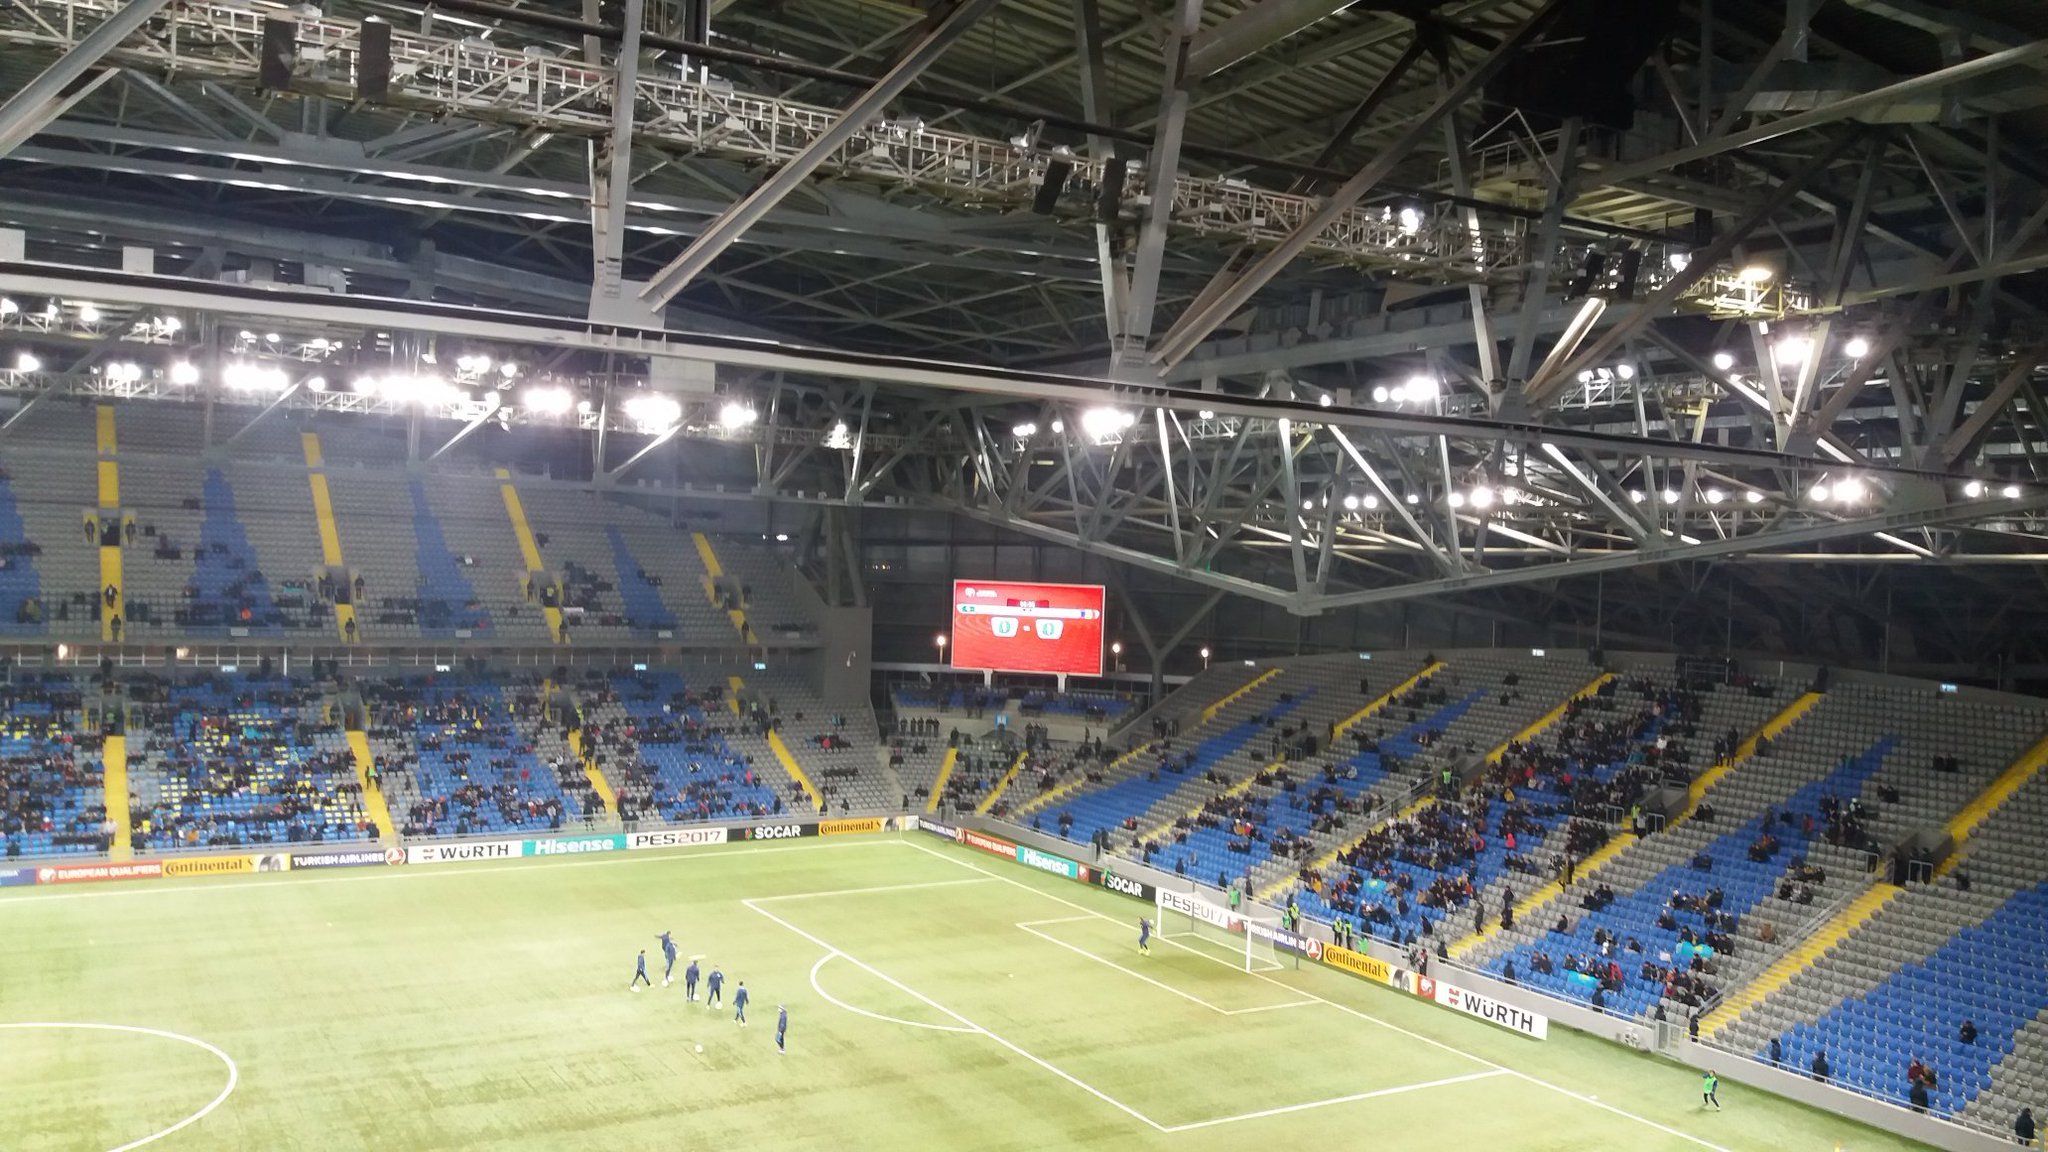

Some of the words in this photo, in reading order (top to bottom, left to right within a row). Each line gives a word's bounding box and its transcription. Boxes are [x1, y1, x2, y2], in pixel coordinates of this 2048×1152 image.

[754, 824, 801, 840] SOCAR
[820, 821, 875, 835] Continental
[440, 843, 509, 860] WÜRTH
[535, 838, 614, 856] Hisense
[164, 858, 243, 876] Continental
[293, 853, 338, 866] TURKISH
[338, 852, 385, 864] AIRLINES
[1023, 846, 1070, 877] Hisense
[58, 867, 108, 880] EUROPEAN
[109, 864, 161, 878] QUALIFIERS
[1106, 874, 1143, 898] SOCAR
[1242, 920, 1273, 940] TRKISH
[1325, 948, 1382, 978] Continental
[1464, 992, 1534, 1033] WÜRTH
